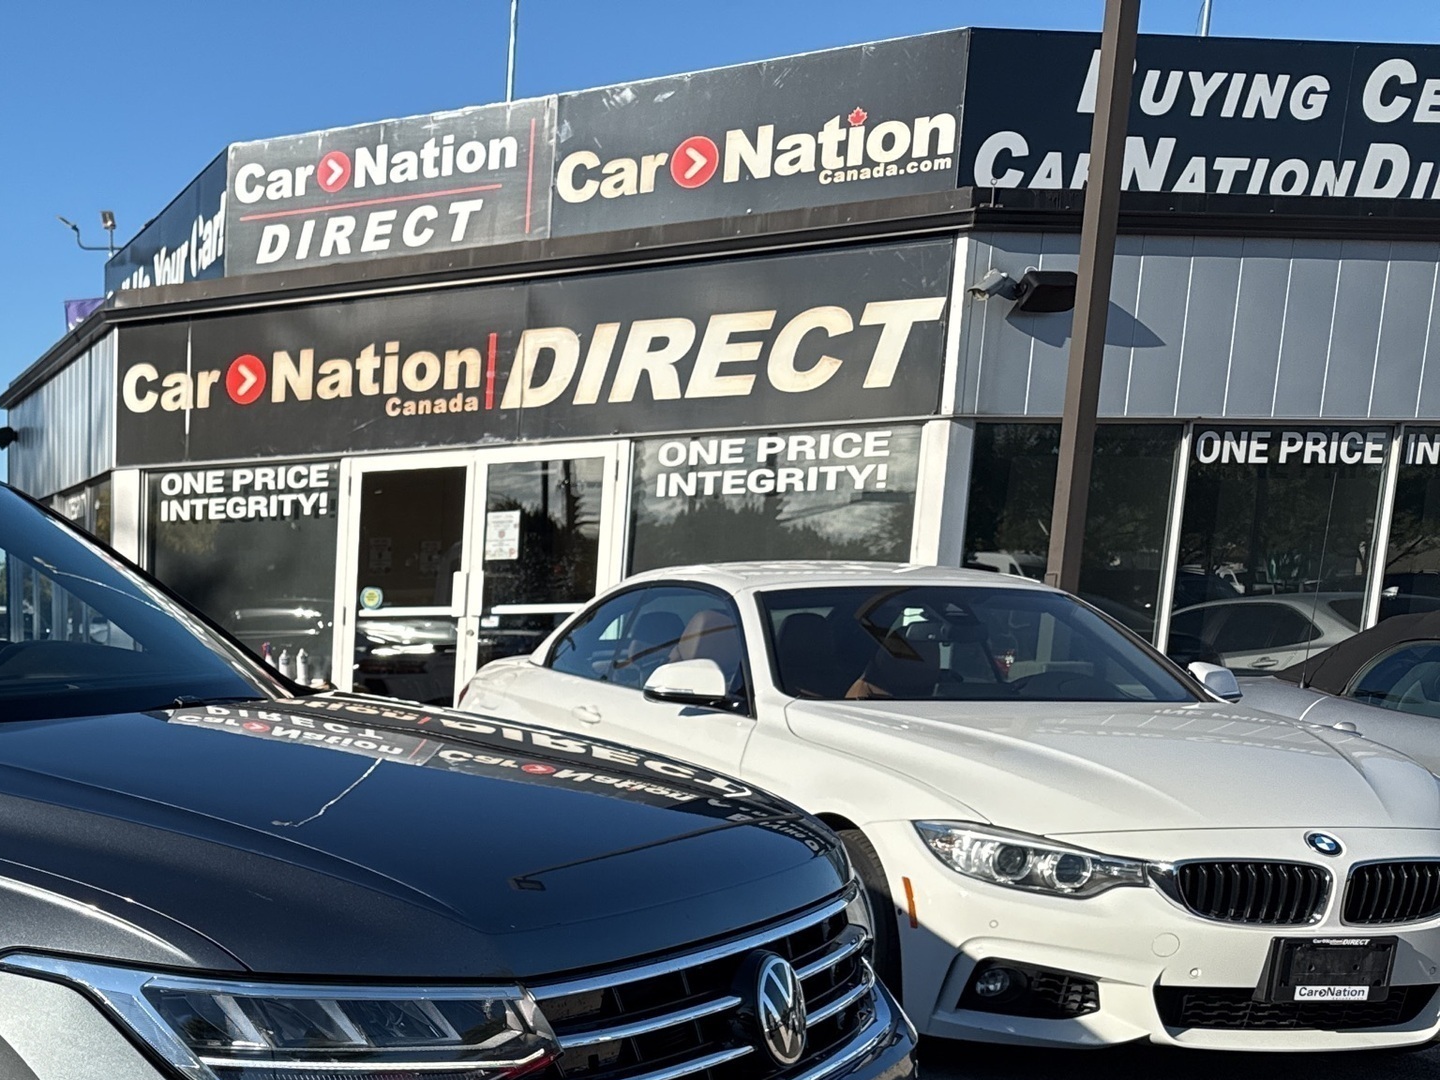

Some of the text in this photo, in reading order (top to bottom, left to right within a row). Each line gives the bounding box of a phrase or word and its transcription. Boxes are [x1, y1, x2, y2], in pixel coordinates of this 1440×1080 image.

[234, 134, 518, 204] Car Nation
[557, 108, 956, 203] Car Nation
[818, 157, 952, 185] Canada.com
[256, 200, 483, 265] DIRECT
[122, 298, 946, 413] Car Nation DIRECT
[385, 393, 479, 417] Canada
[658, 430, 893, 467] ONE PRICE
[1197, 431, 1272, 464] ONE
[1279, 431, 1387, 464] PRICE
[160, 464, 330, 496] ONE PRICE
[656, 464, 888, 497] INTEGRITY!
[160, 492, 328, 522] INTEGRITY!
[1326, 986, 1365, 997] Nation
